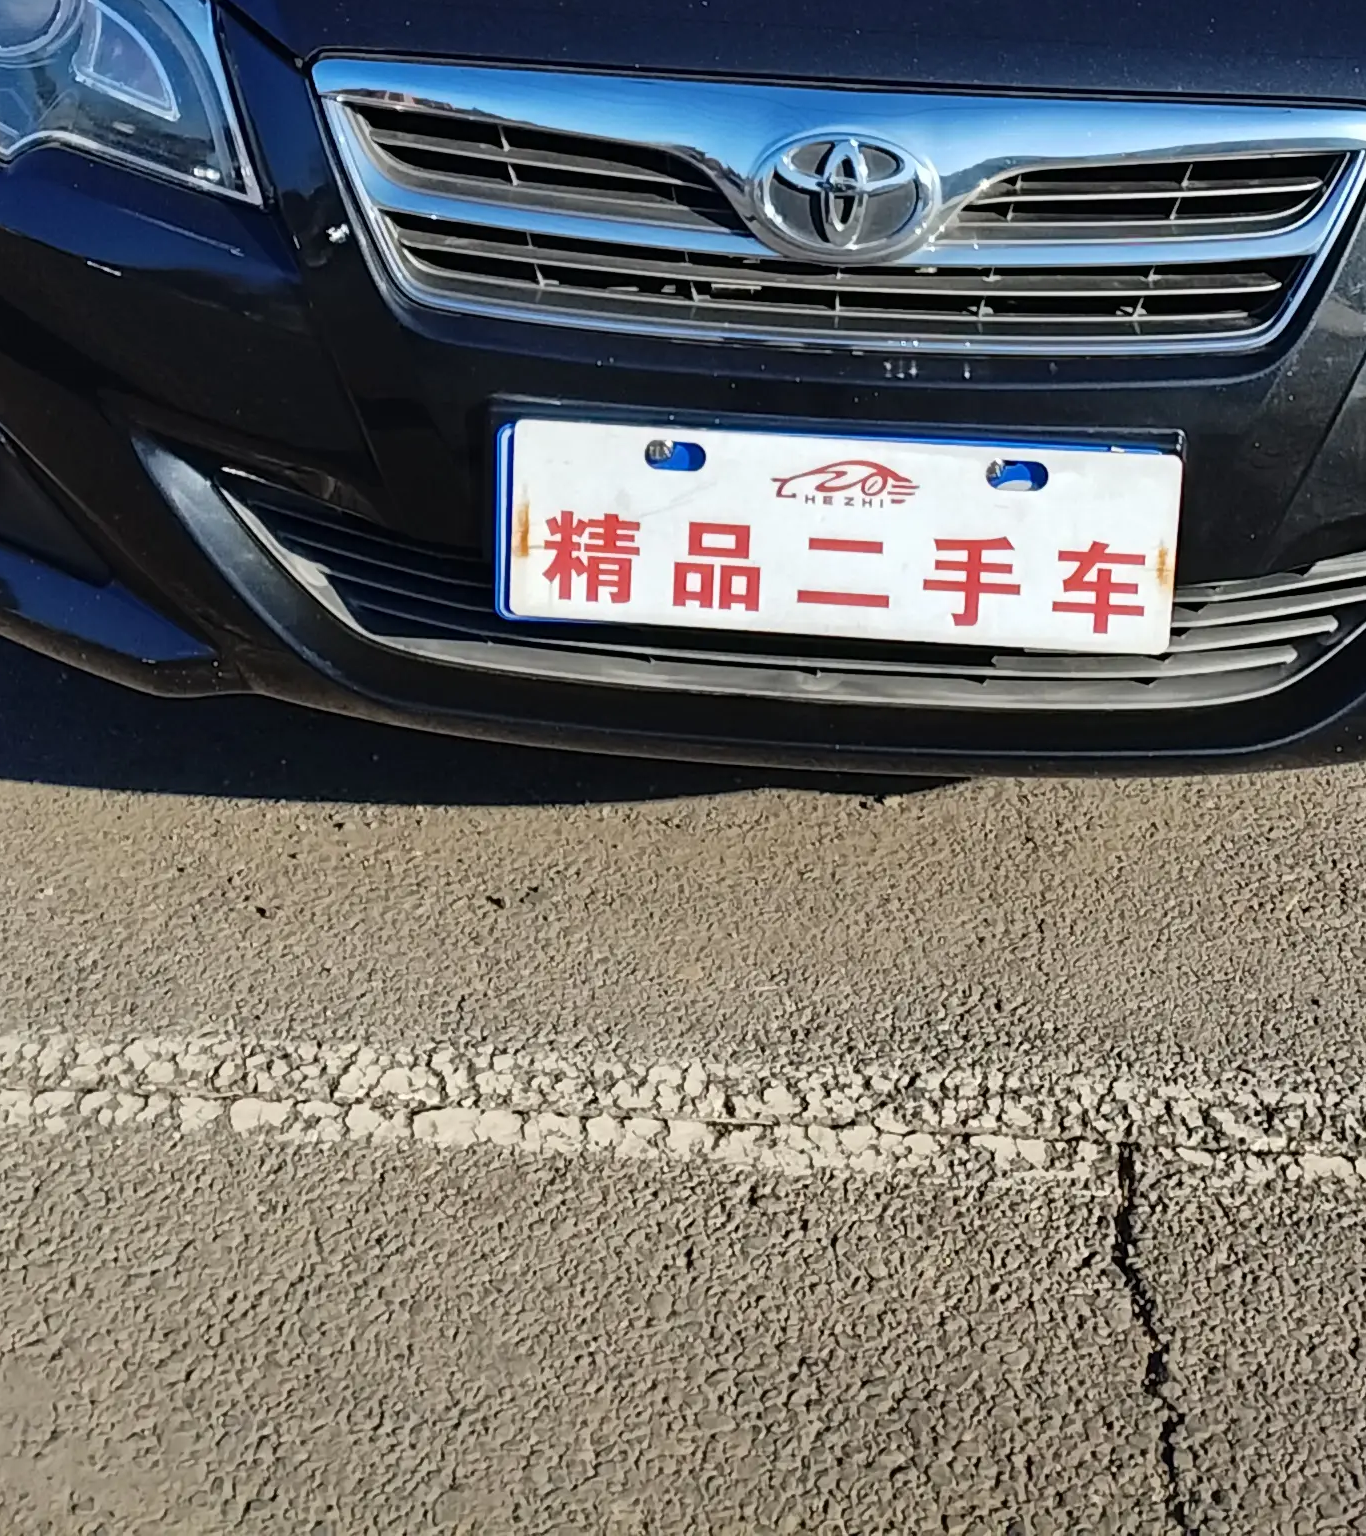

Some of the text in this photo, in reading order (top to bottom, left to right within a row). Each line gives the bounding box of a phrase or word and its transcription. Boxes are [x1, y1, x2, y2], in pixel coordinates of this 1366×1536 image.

[804, 493, 884, 509] HEZHI
[542, 509, 1147, 635] 精品二手车
